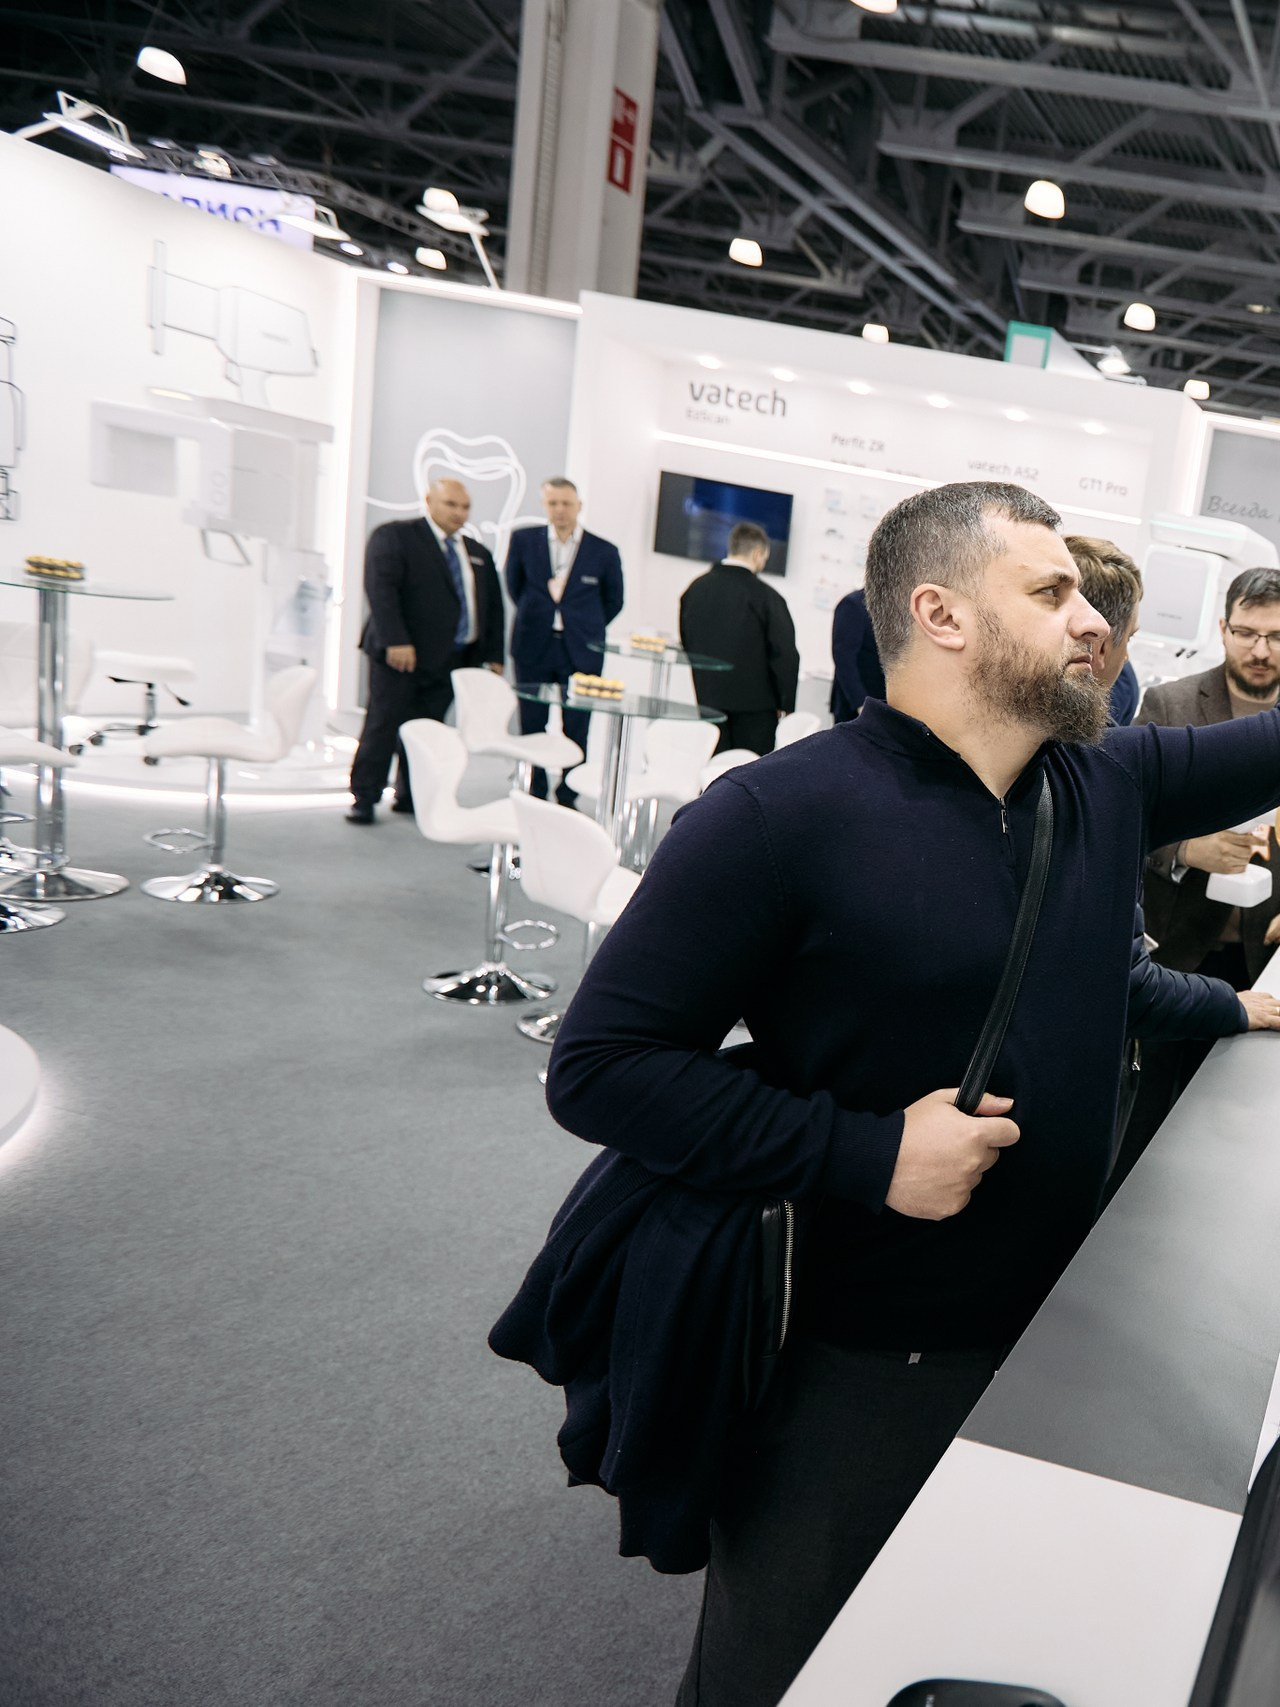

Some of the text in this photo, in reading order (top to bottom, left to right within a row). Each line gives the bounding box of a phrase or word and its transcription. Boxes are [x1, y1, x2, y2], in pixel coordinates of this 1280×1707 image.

[689, 380, 787, 417] vatech
[967, 459, 1011, 476] vatech
[1105, 481, 1129, 497] Pro
[1206, 495, 1274, 520] Всегда
